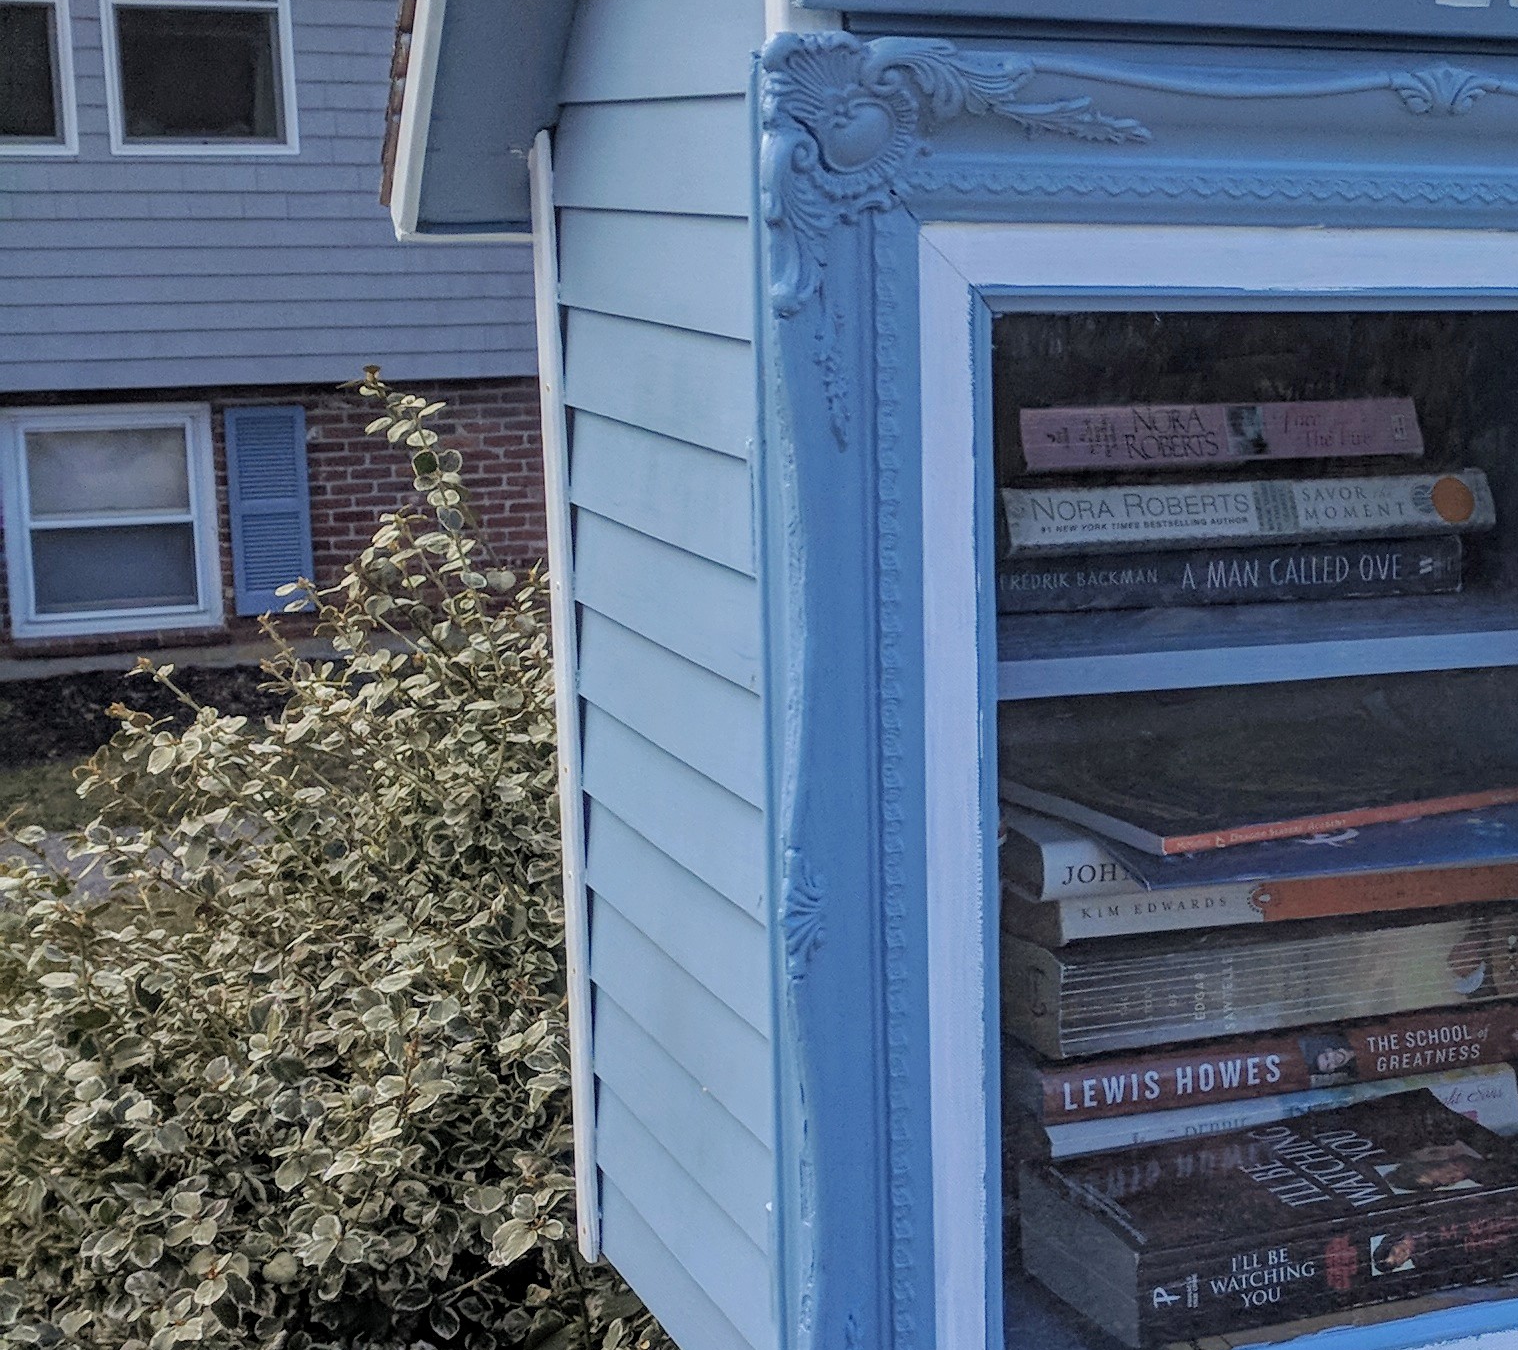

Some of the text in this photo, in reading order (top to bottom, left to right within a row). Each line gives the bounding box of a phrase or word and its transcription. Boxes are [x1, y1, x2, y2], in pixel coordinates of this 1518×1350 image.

[1132, 407, 1205, 435] NORA
[1122, 431, 1220, 460] ROBERTS
[1030, 497, 1115, 522] NORA
[1122, 492, 1250, 518] ROBERTS
[1302, 484, 1368, 502] SAVOR
[1056, 524, 1078, 533] NEW
[1082, 523, 1107, 531] YORK
[1111, 521, 1140, 530] TIMES
[1143, 518, 1207, 530] BESTSELLING
[1210, 516, 1249, 526] AUTHOR
[1304, 501, 1407, 522] MOMENT
[1076, 569, 1158, 588] BACKMAN
[1181, 563, 1196, 590] A
[1207, 559, 1260, 589] MAN
[1269, 555, 1350, 586] CALLED
[1359, 553, 1403, 582] OVE
[1081, 897, 1228, 919] KIM EDWARDS
[1366, 1022, 1491, 1053] THE SCHOOL of
[1375, 1043, 1481, 1072] GREATNESS
[1062, 1053, 1281, 1111] LEWIS HOWES
[1312, 1128, 1388, 1162] YOU
[1247, 1125, 1389, 1208] WATCHING
[1239, 1159, 1334, 1208] I'LL BE
[1231, 1247, 1289, 1272] I'LL BE
[1209, 1260, 1316, 1295] WATCHING
[1240, 1286, 1282, 1308] YOU
